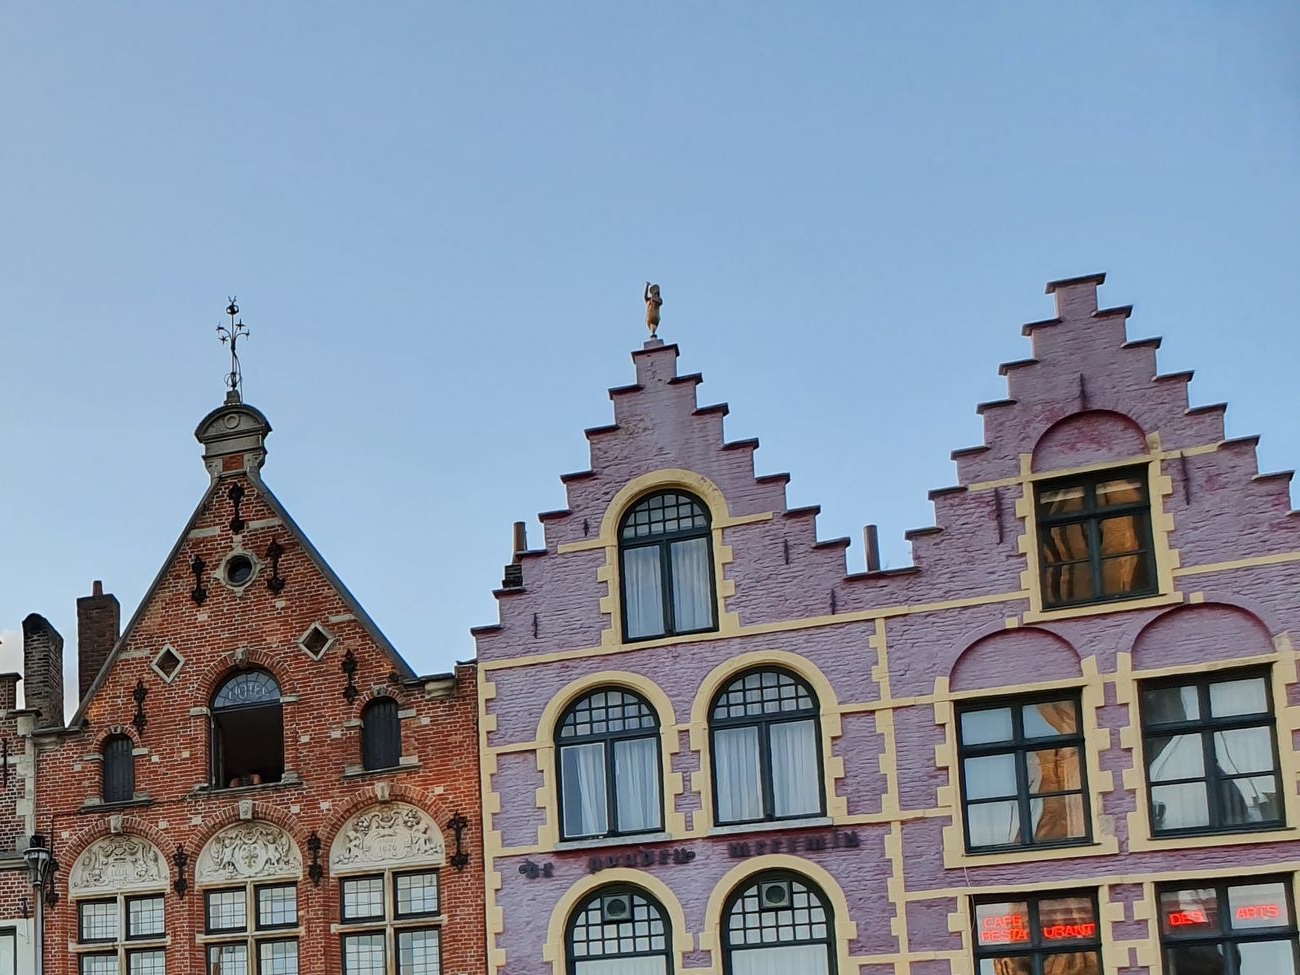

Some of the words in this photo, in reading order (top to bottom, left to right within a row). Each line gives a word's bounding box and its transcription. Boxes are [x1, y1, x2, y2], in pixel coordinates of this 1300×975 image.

[228, 682, 270, 700] HOTEL
[1235, 904, 1279, 919] ARTS
[983, 913, 1023, 929] CAFE
